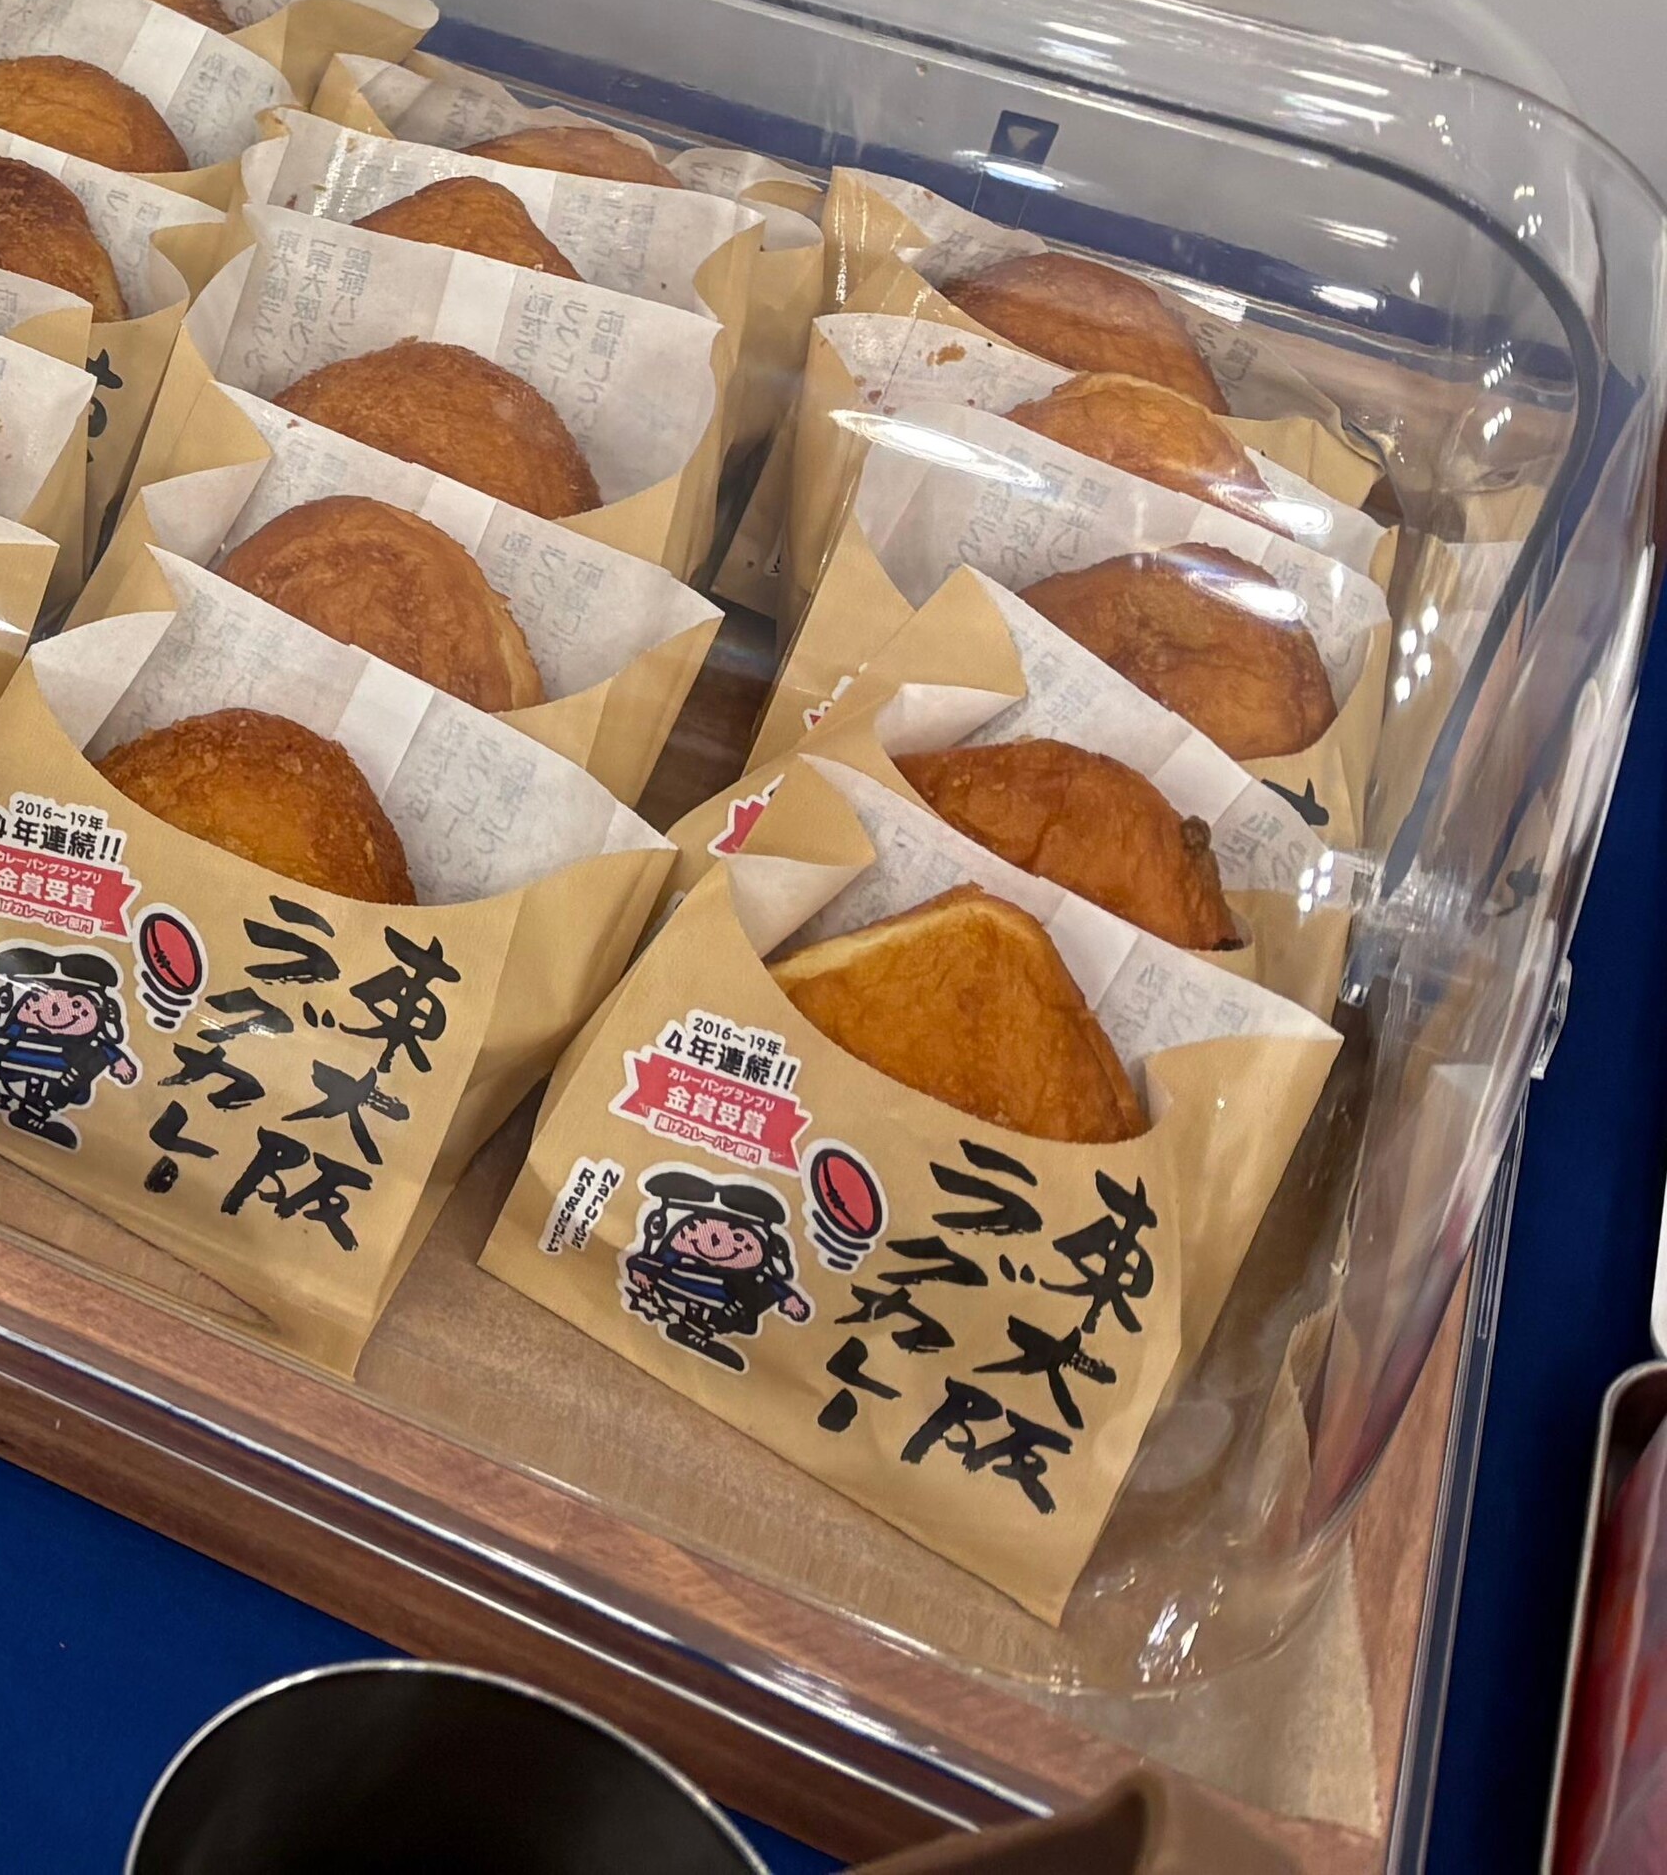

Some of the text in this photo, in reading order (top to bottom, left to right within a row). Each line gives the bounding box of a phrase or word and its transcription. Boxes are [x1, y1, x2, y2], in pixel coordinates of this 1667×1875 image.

[221, 926, 462, 1251] 東大阪
[664, 1085, 766, 1140] 金賞受賞
[901, 1169, 1158, 1515] 東大阪
